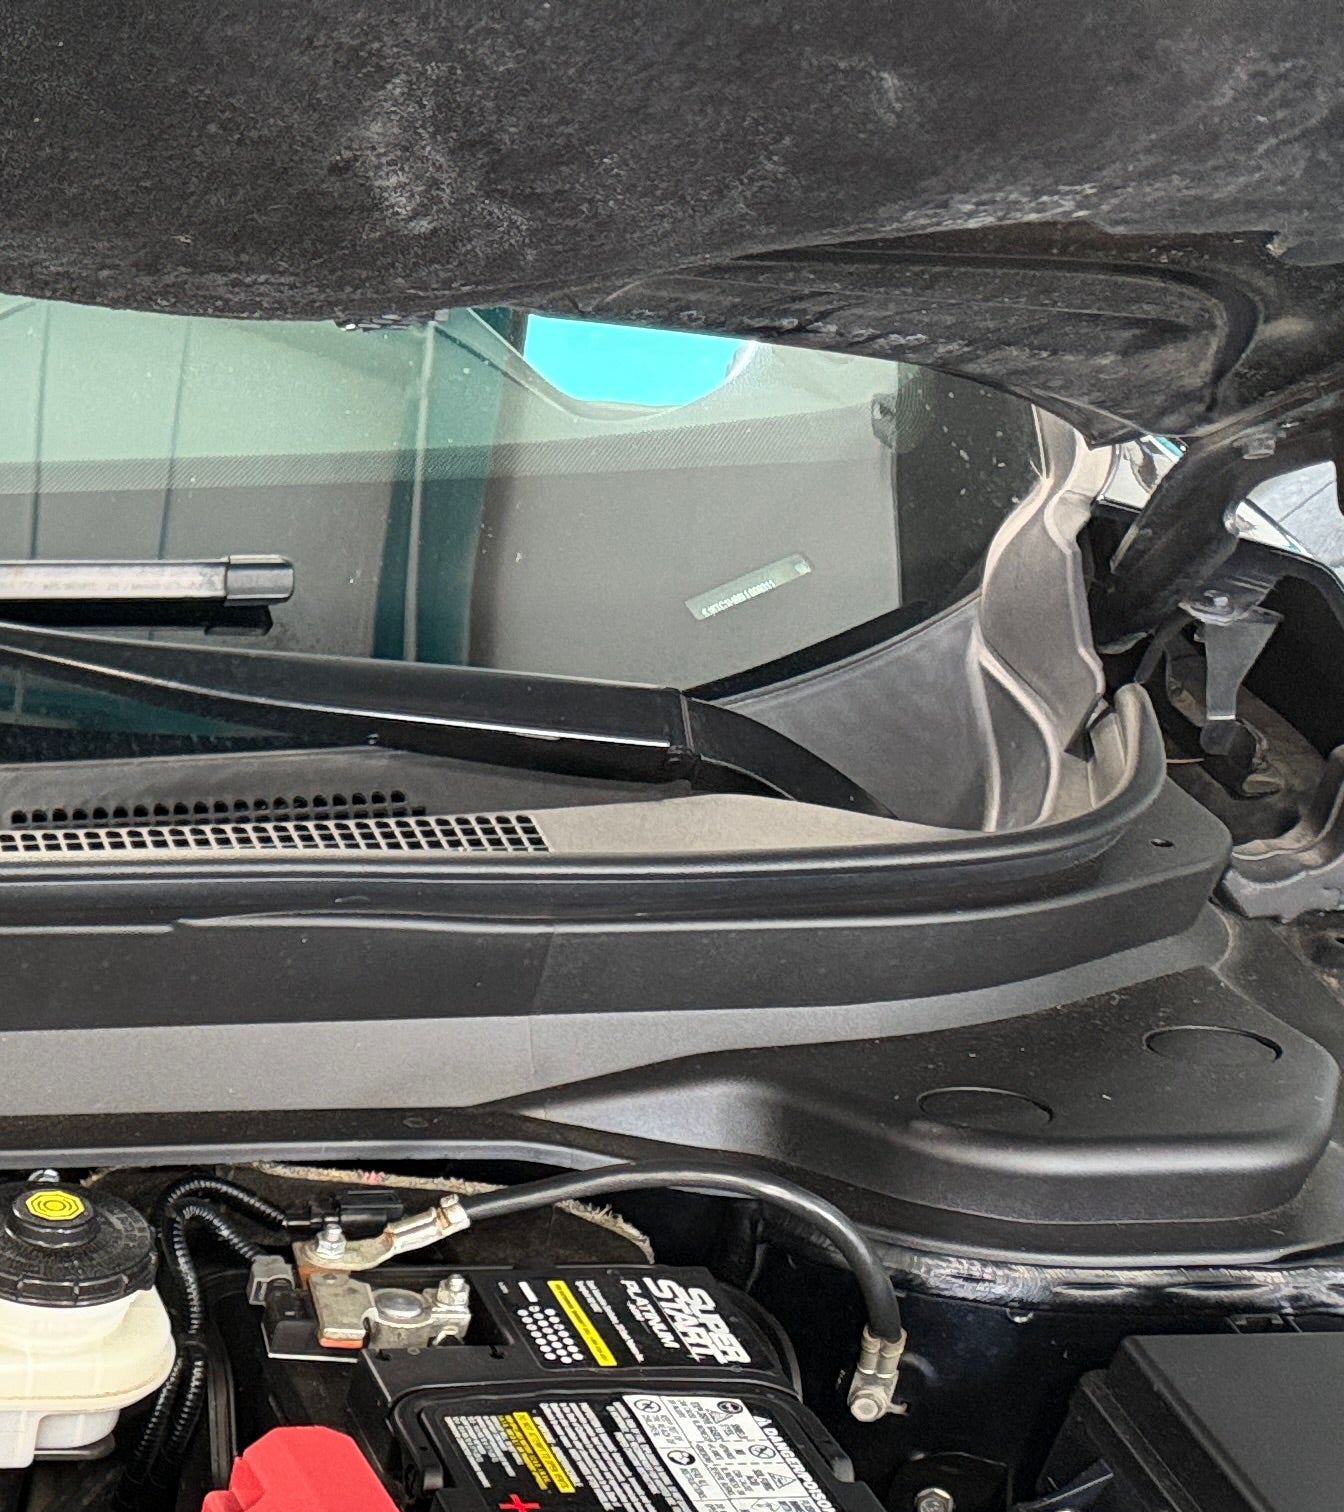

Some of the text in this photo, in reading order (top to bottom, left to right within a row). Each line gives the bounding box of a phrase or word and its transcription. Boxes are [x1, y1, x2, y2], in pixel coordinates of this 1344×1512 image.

[621, 1280, 680, 1348] PLATINUM
[642, 1278, 731, 1364] START
[688, 1288, 751, 1363] SUPER
